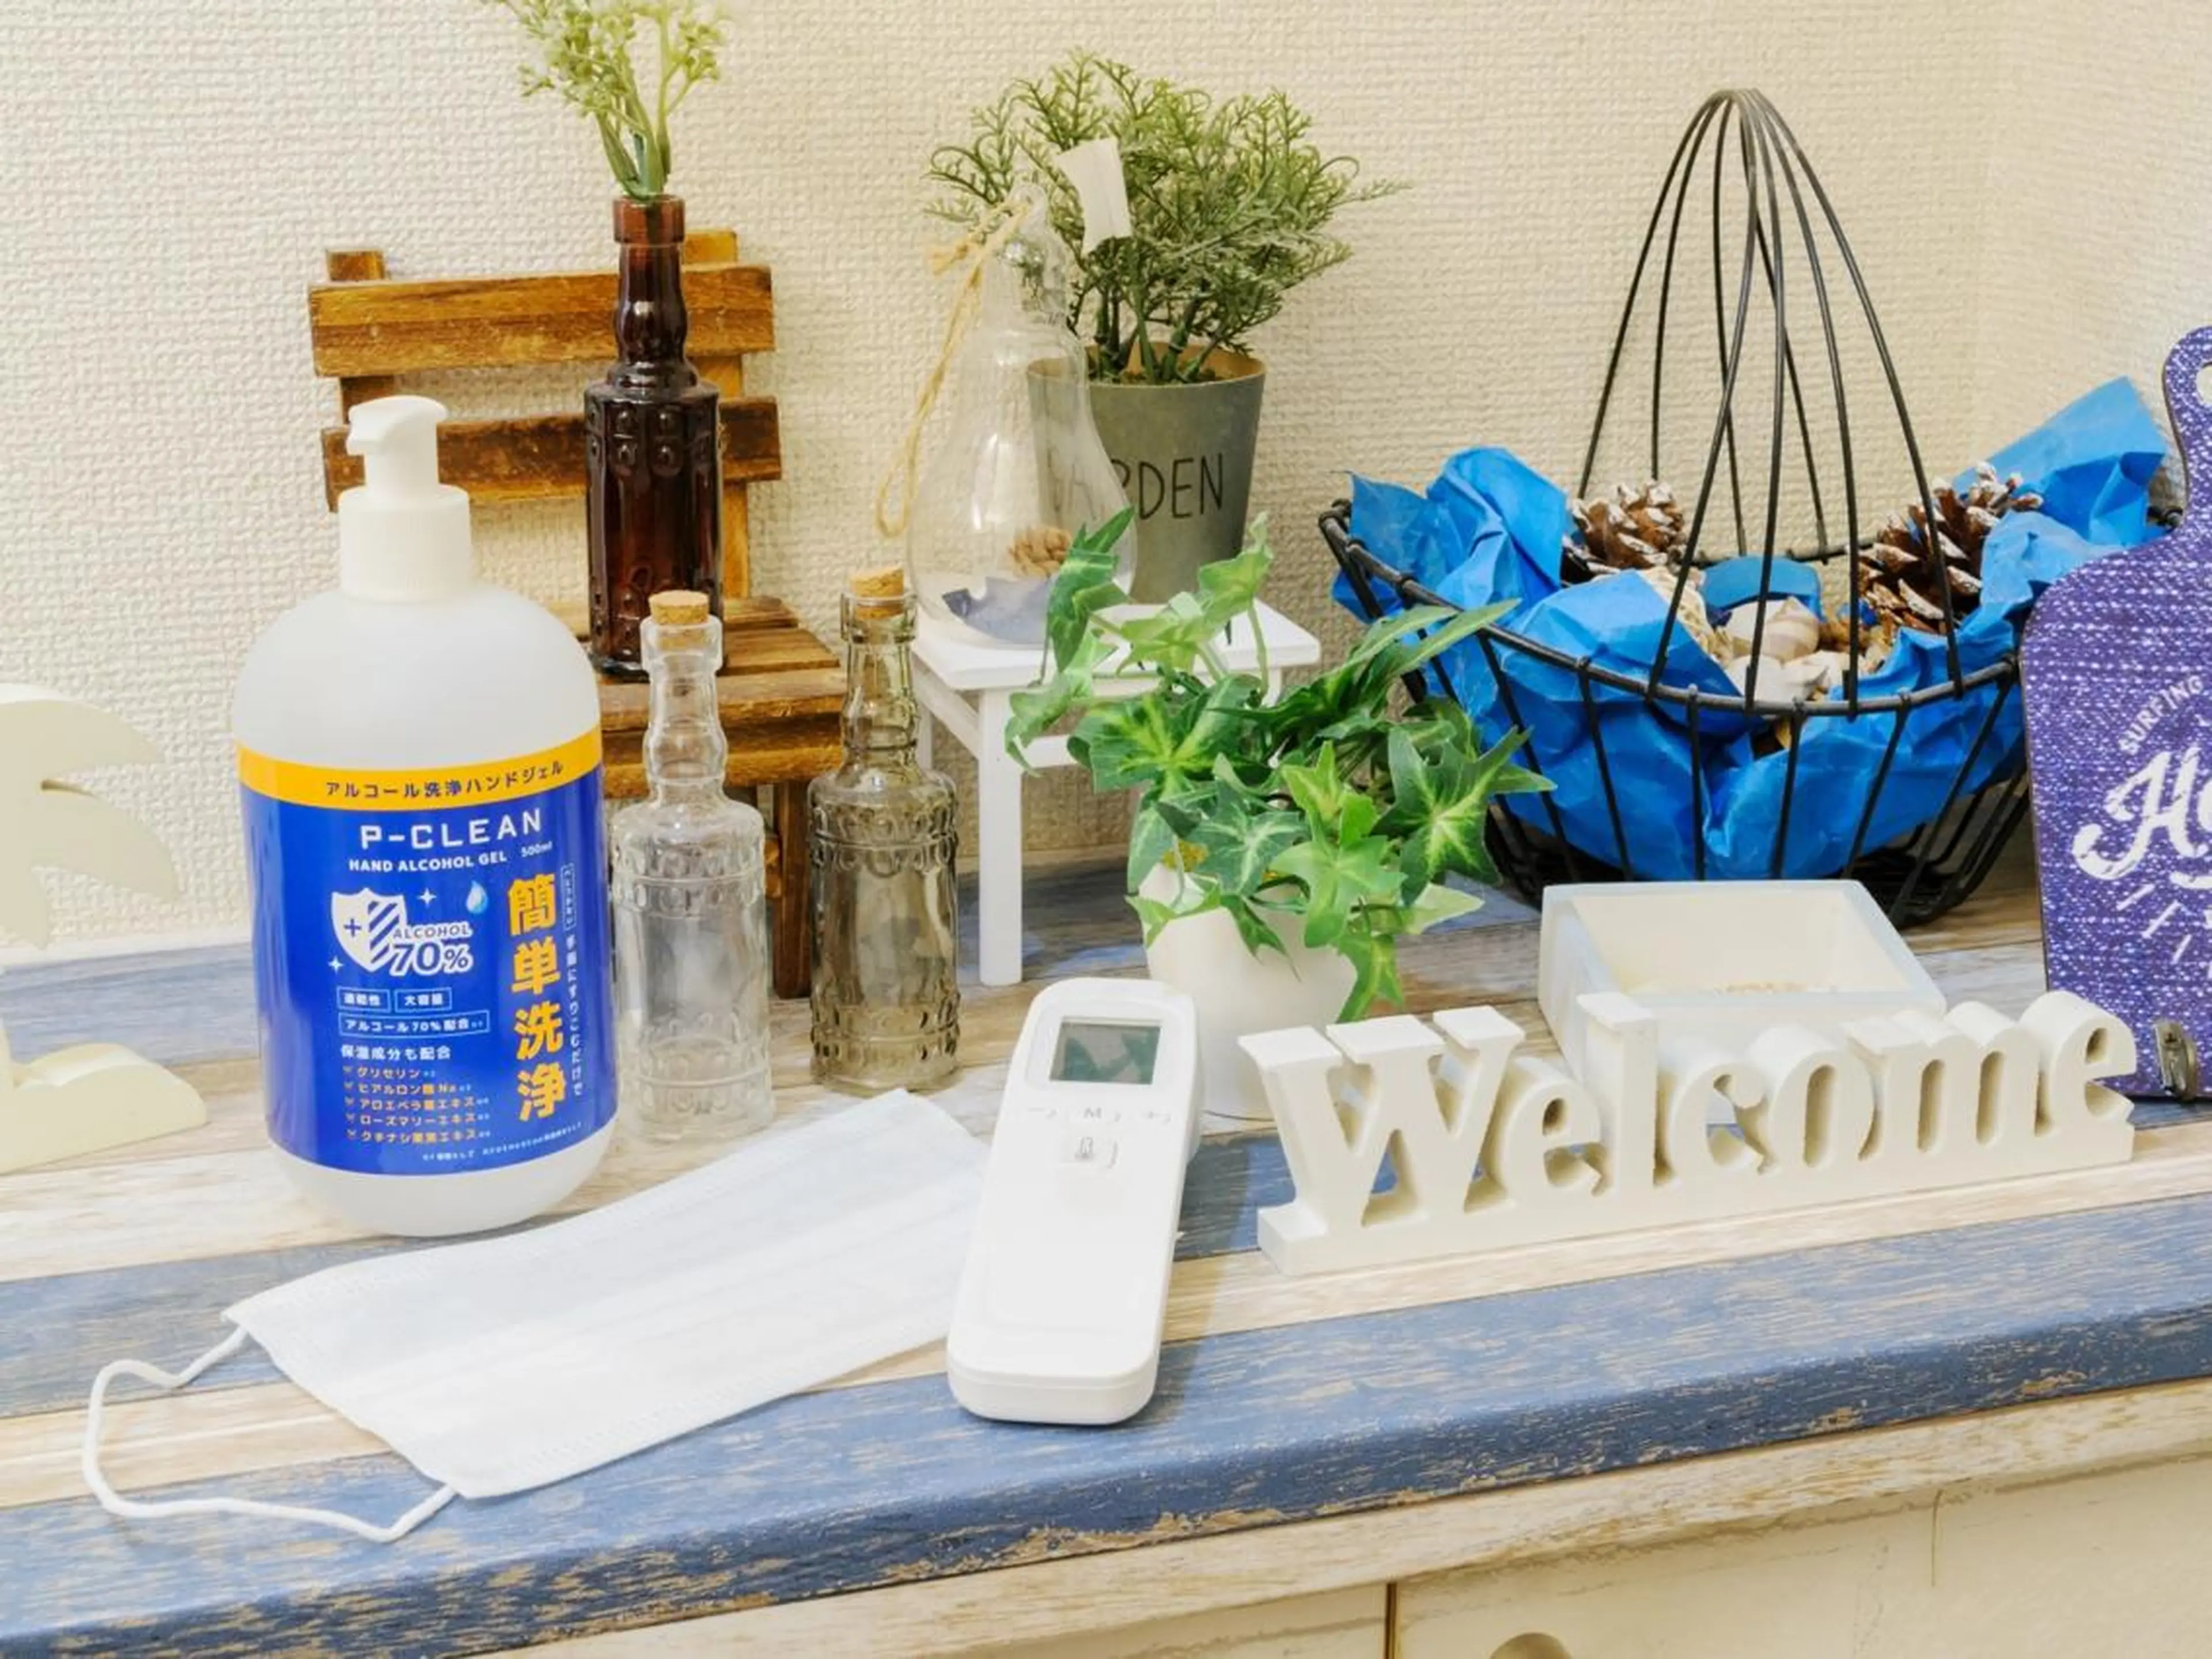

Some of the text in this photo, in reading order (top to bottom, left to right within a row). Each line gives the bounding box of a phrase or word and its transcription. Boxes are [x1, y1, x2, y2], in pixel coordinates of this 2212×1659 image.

[2118, 675, 2203, 755] SURFING
[326, 760, 563, 798] アルコール洗浄ハンドジェル
[359, 808, 541, 850] P-CLEAN
[349, 858, 393, 872] HAND
[398, 856, 474, 872] ALCOHOL
[478, 850, 507, 866] GEL
[392, 923, 471, 940] ALCOHOL
[393, 941, 469, 974] 70%
[509, 873, 566, 1122] 簡単洗浄
[1237, 990, 2138, 1244] Welcome
